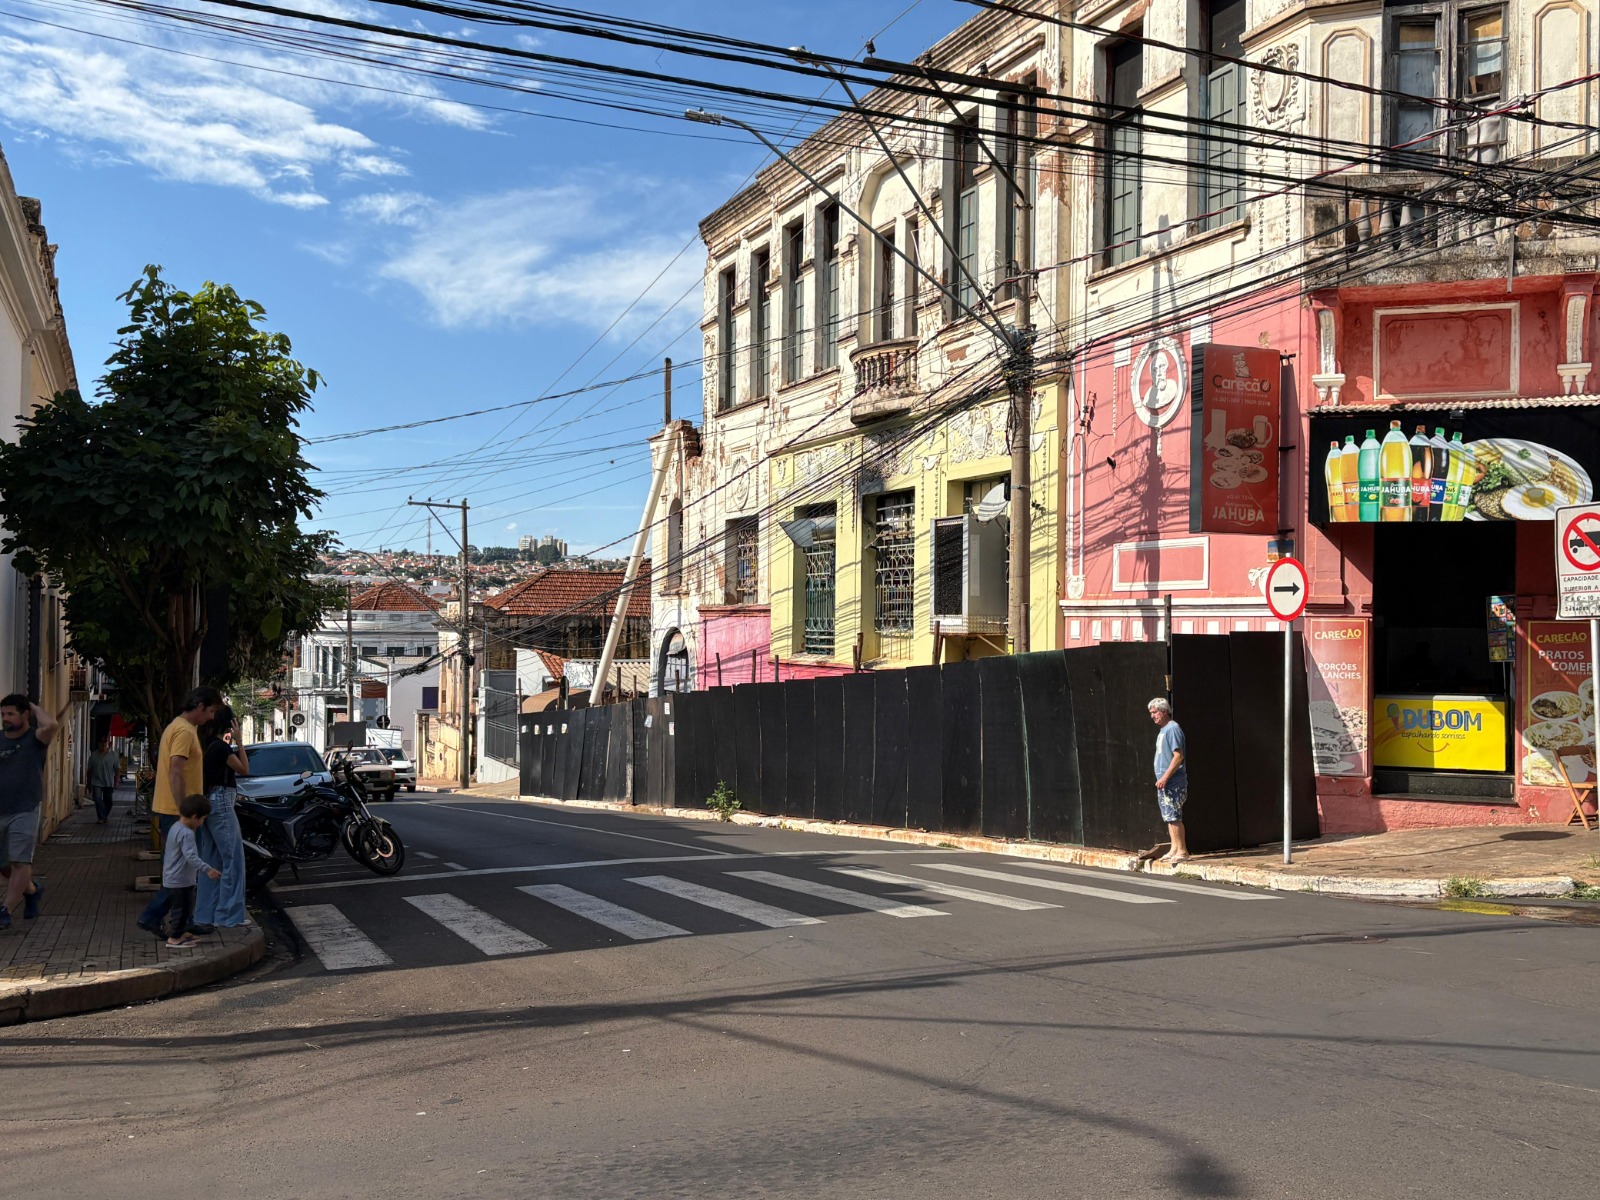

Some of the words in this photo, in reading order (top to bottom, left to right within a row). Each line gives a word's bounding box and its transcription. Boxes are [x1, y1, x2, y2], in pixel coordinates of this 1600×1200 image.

[1381, 485, 1411, 494] JAHUBA
[1212, 506, 1265, 522] JAHUBA
[1538, 650, 1585, 660] PRATOS
[1318, 662, 1357, 673] PORÇÕES
[1322, 671, 1361, 679] LANCHES
[1403, 709, 1482, 731] DUBOM
